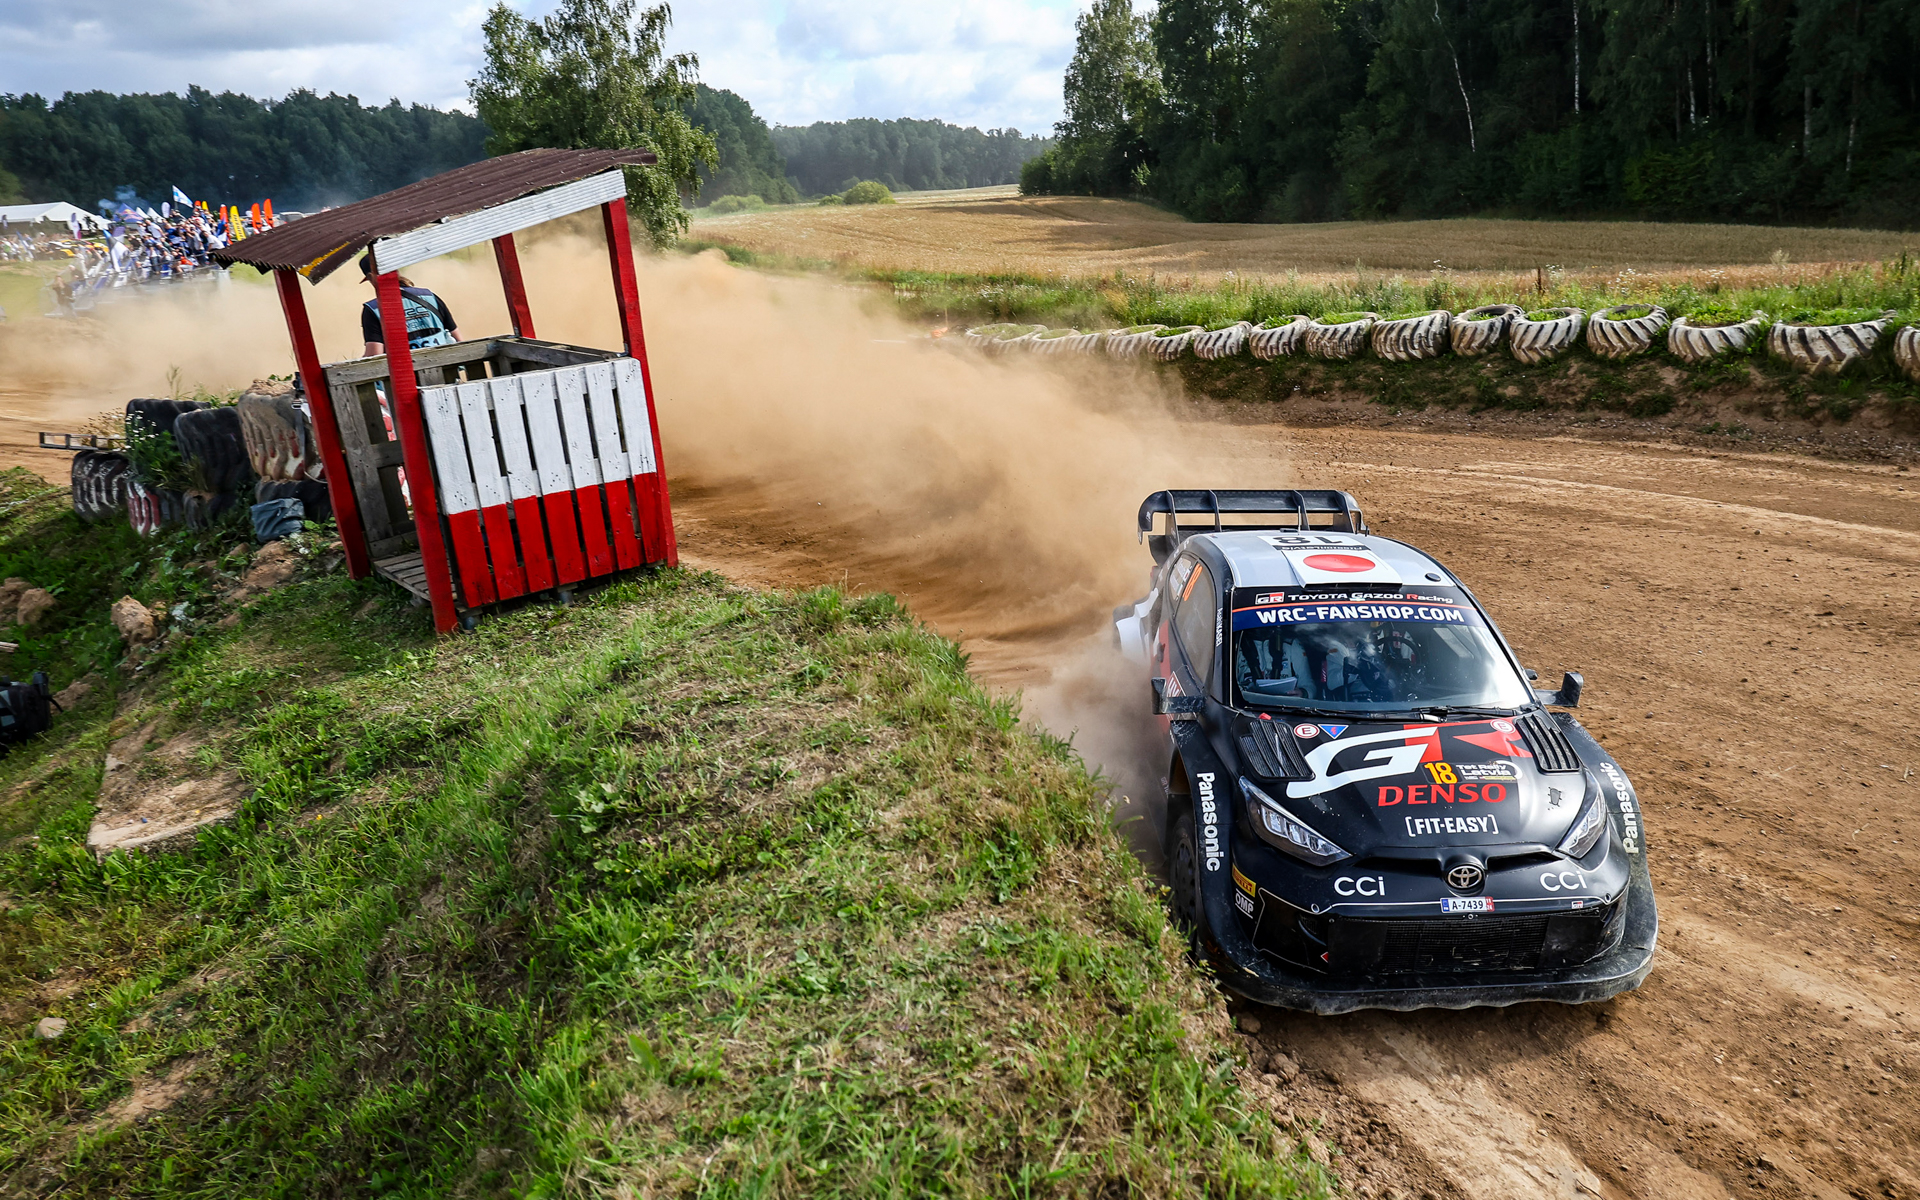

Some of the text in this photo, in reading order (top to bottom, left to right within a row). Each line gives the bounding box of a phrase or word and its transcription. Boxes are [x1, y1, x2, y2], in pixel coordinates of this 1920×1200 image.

[1272, 536, 1342, 544] 18
[1257, 593, 1283, 604] GR
[1288, 591, 1453, 604] TOYOTA GAZOO Racing
[1256, 606, 1465, 624] WRC-FANSHOP.COM
[1424, 762, 1458, 785] 18
[1378, 783, 1507, 806] DENSO
[1600, 762, 1639, 854] Panasonic
[1197, 772, 1224, 872] Panasonic
[1235, 892, 1254, 914] OMP
[1452, 900, 1484, 910] A-7439
